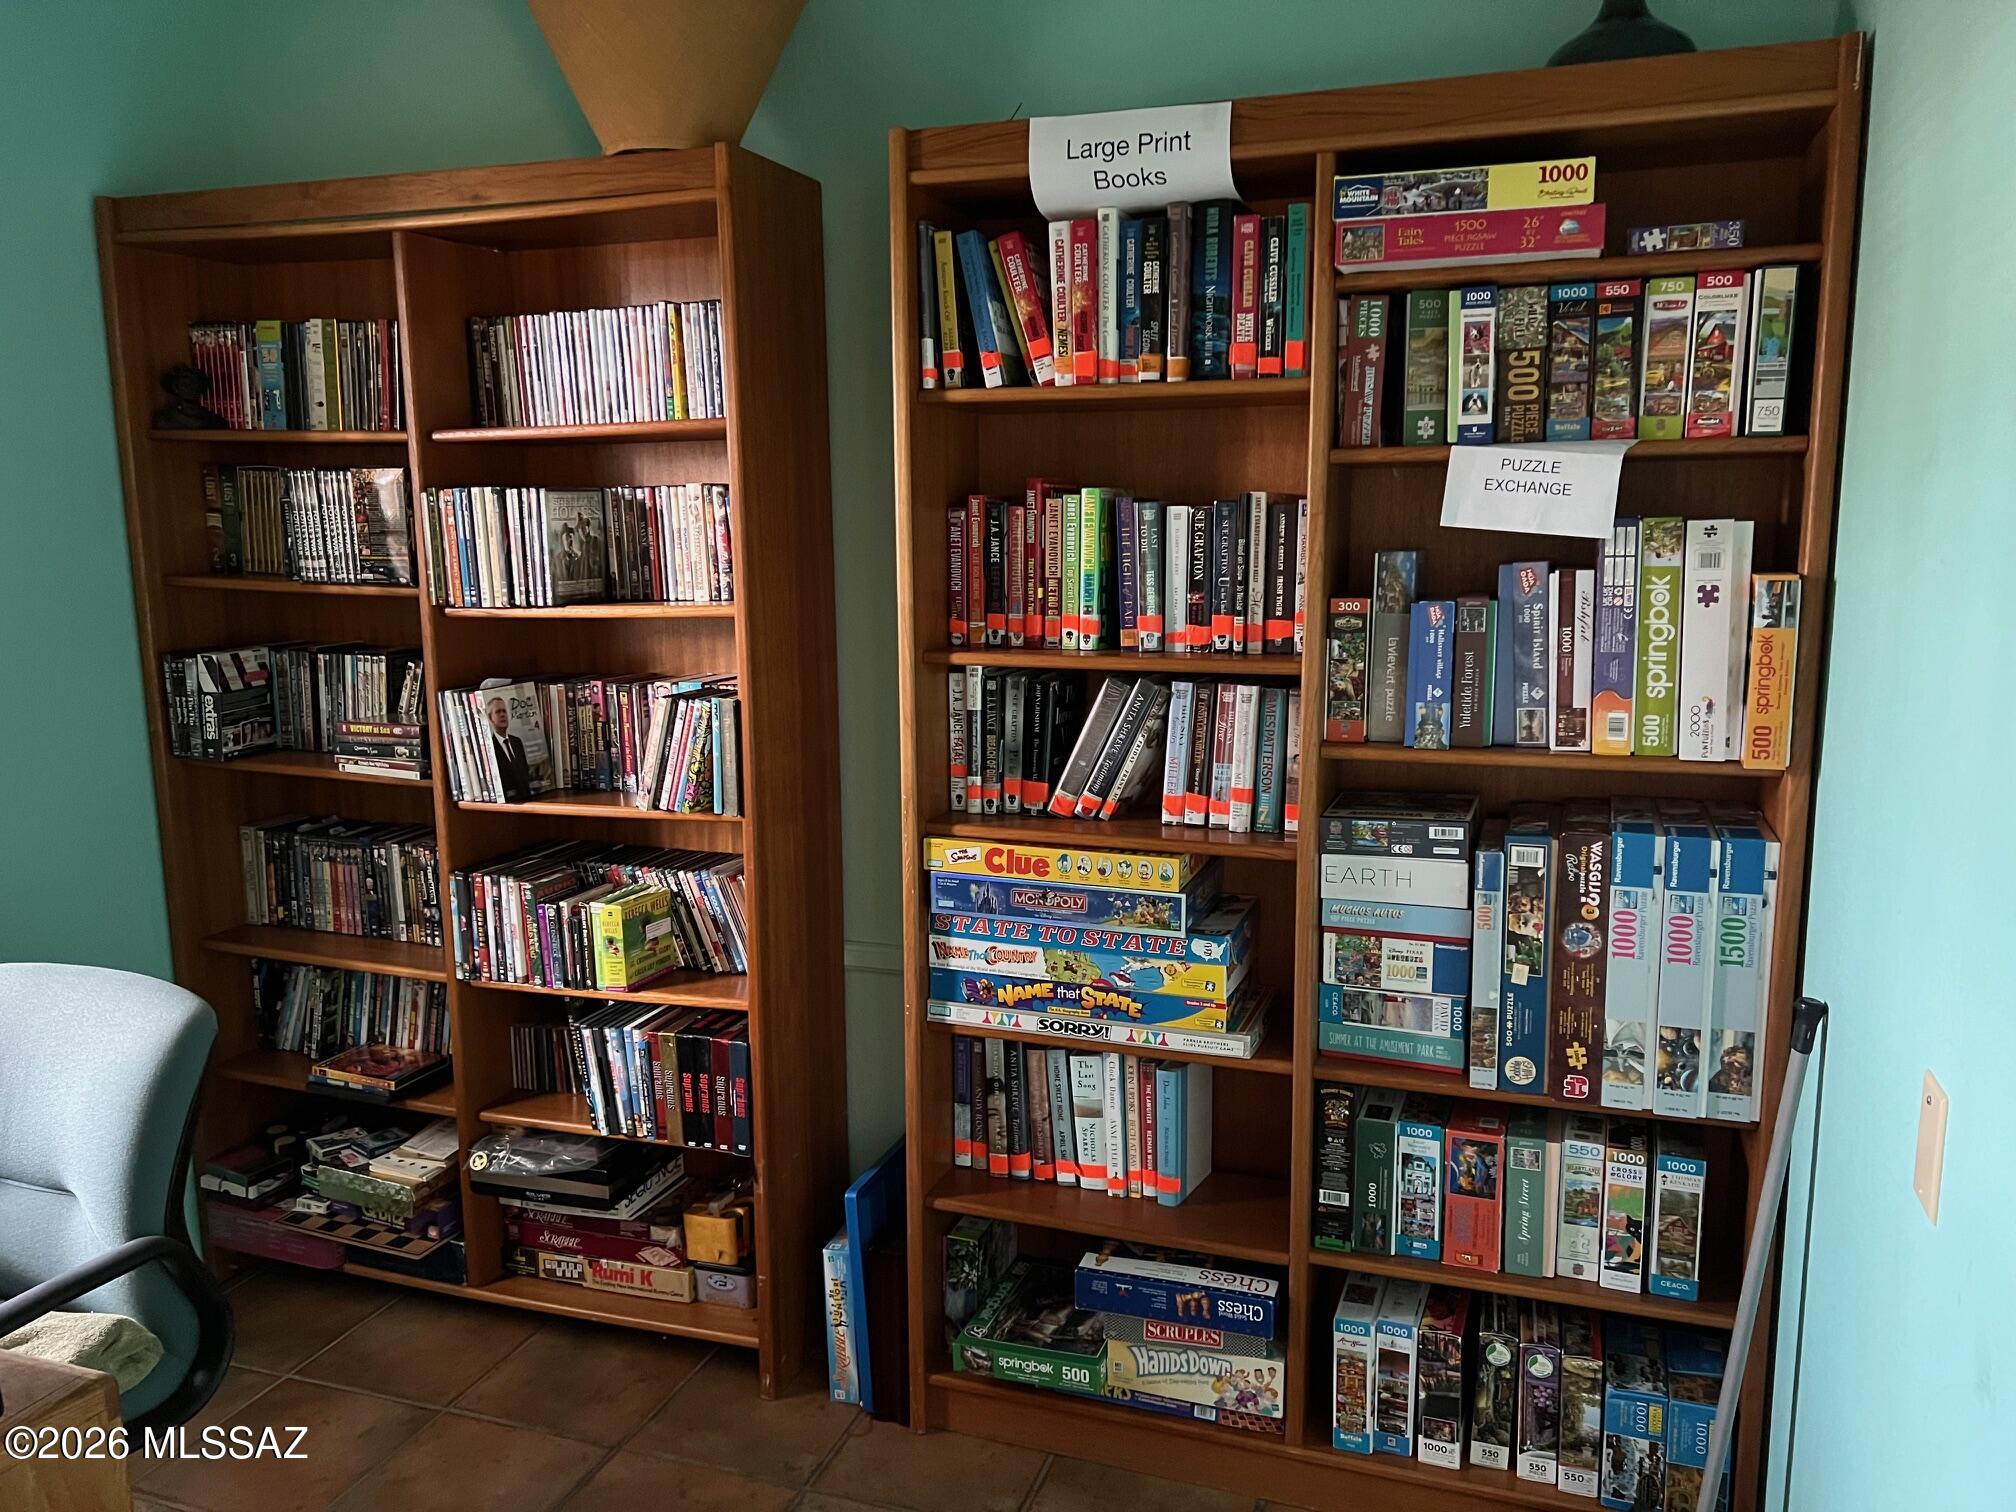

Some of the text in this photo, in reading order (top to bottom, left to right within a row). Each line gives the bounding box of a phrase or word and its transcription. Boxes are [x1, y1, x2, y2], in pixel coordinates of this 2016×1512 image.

[1067, 131, 1191, 162] Large Print
[1094, 169, 1167, 190] Books
[1538, 163, 1588, 184] 1000
[1339, 195, 1378, 204] MOUNTAIN
[1397, 227, 1424, 239] Fairy
[1455, 219, 1487, 231] 1500
[1727, 221, 1741, 246] 350
[1270, 237, 1279, 263] CLIVE
[1397, 236, 1424, 245] Tales
[1074, 244, 1083, 285] COULTER
[1244, 240, 1254, 268] CLIVE
[1126, 238, 1135, 308] CATHERINE COULTER
[1143, 261, 1152, 295] COULTER
[1269, 264, 1279, 303] CUSSLER
[1706, 275, 1733, 287] 500
[1243, 268, 1254, 308] CUSSLER
[1466, 291, 1491, 302] 1000
[1558, 287, 1588, 299] 1000
[1605, 285, 1630, 296] 550
[1660, 282, 1685, 292] 750
[1418, 300, 1441, 309] 500
[1237, 313, 1246, 343] DEATH
[1246, 313, 1254, 342] WHITE
[1358, 300, 1368, 337] PIECES
[1369, 300, 1383, 337] 1000
[1508, 351, 1540, 401] 500
[1526, 404, 1540, 434] PIECE
[1757, 405, 1780, 416] 750
[1361, 406, 1374, 446] PUZZLE
[1511, 405, 1525, 443] PUZZLE
[1501, 458, 1562, 474] PUZZLE
[1484, 478, 1574, 496] EXCHANGE
[1049, 503, 1058, 529] JANET
[1221, 519, 1229, 536] SUE
[990, 520, 1000, 562] J.A. JANCE
[1151, 528, 1159, 550] LAST
[1193, 510, 1205, 580] SUE GRAFTON
[1049, 531, 1059, 576] EVANOVICH
[1220, 537, 1229, 574] GRAFTON
[1048, 579, 1058, 607] METRO
[1338, 602, 1361, 611] 300
[1523, 604, 1531, 624] 1000
[1532, 603, 1545, 670] Spirit Island
[1561, 627, 1573, 653] 1000
[1642, 575, 1675, 748] 500 springbok
[1459, 650, 1475, 729] Yuletide Forest
[1752, 635, 1776, 761] 500 springbok
[204, 695, 218, 740] extras
[350, 724, 373, 733] VICTORY
[1690, 705, 1701, 738] 2000
[1091, 693, 1145, 795] ANITA SHREVE Testimony
[1260, 729, 1276, 795] PATTERSON
[1167, 756, 1179, 795] MILLER
[985, 847, 1051, 878] Clue
[1565, 853, 1579, 881] Retro
[1613, 837, 1625, 883] Ravensburger
[1670, 841, 1681, 888] Ravensburger
[1722, 842, 1734, 889] Ravensburger
[1325, 865, 1412, 890] EARTH
[1013, 891, 1086, 911] MONOPOLY
[1329, 904, 1405, 920] MUCHOS AUTOS
[1477, 906, 1491, 929] 500
[934, 913, 1188, 957] STATE TO STATE
[1612, 911, 1637, 960] 1000
[1667, 915, 1694, 966] 1000
[1719, 917, 1747, 968] 1500
[1386, 964, 1415, 980] 1000
[997, 982, 1055, 1007] NAME
[1057, 985, 1081, 1000] that
[1080, 984, 1143, 1018] STATE
[1037, 1016, 1112, 1040] SORRY!
[1452, 1006, 1462, 1031] 1000
[1355, 1035, 1362, 1048] AT
[1363, 1036, 1377, 1050] THE
[1379, 1038, 1414, 1055] AMUSEMENT
[1416, 1041, 1435, 1058] PARK
[1109, 1061, 1117, 1082] Clock
[1080, 1077, 1091, 1097] Song
[1109, 1086, 1117, 1109] Dance
[1010, 1050, 1021, 1153] ANITA SHREVE Testimony
[1053, 1065, 1067, 1147] HOME SWEET HOME APRIL
[1081, 1128, 1090, 1157] SPARKS
[1089, 1123, 1098, 1163] NICHOLAS
[1407, 1127, 1433, 1138] 1000
[1568, 1145, 1600, 1157] 550
[1612, 1151, 1645, 1165] 1000
[1611, 1166, 1638, 1175] CROSS
[1667, 1161, 1696, 1172] 1000
[1368, 1182, 1377, 1208] 1000
[539, 1229, 583, 1250] SCRABBLE
[590, 1258, 656, 1289] Rumi K
[1198, 1269, 1270, 1293] Chess
[1660, 1281, 1689, 1291] CEACO
[1217, 1299, 1263, 1322] Chess
[1147, 1322, 1220, 1346] SCRUPLES
[1340, 1323, 1365, 1334] 1000
[1382, 1324, 1408, 1336] 1000
[998, 1355, 1054, 1375] springbok
[1062, 1366, 1090, 1383] 500
[1635, 1401, 1647, 1432] 1000
[1340, 1433, 1363, 1442] Buffalo
[1423, 1441, 1447, 1454] 1000
[1695, 1422, 1708, 1455] 1000
[1482, 1448, 1499, 1458] 550
[1529, 1462, 1547, 1472] 550
[1564, 1472, 1585, 1483] 550
